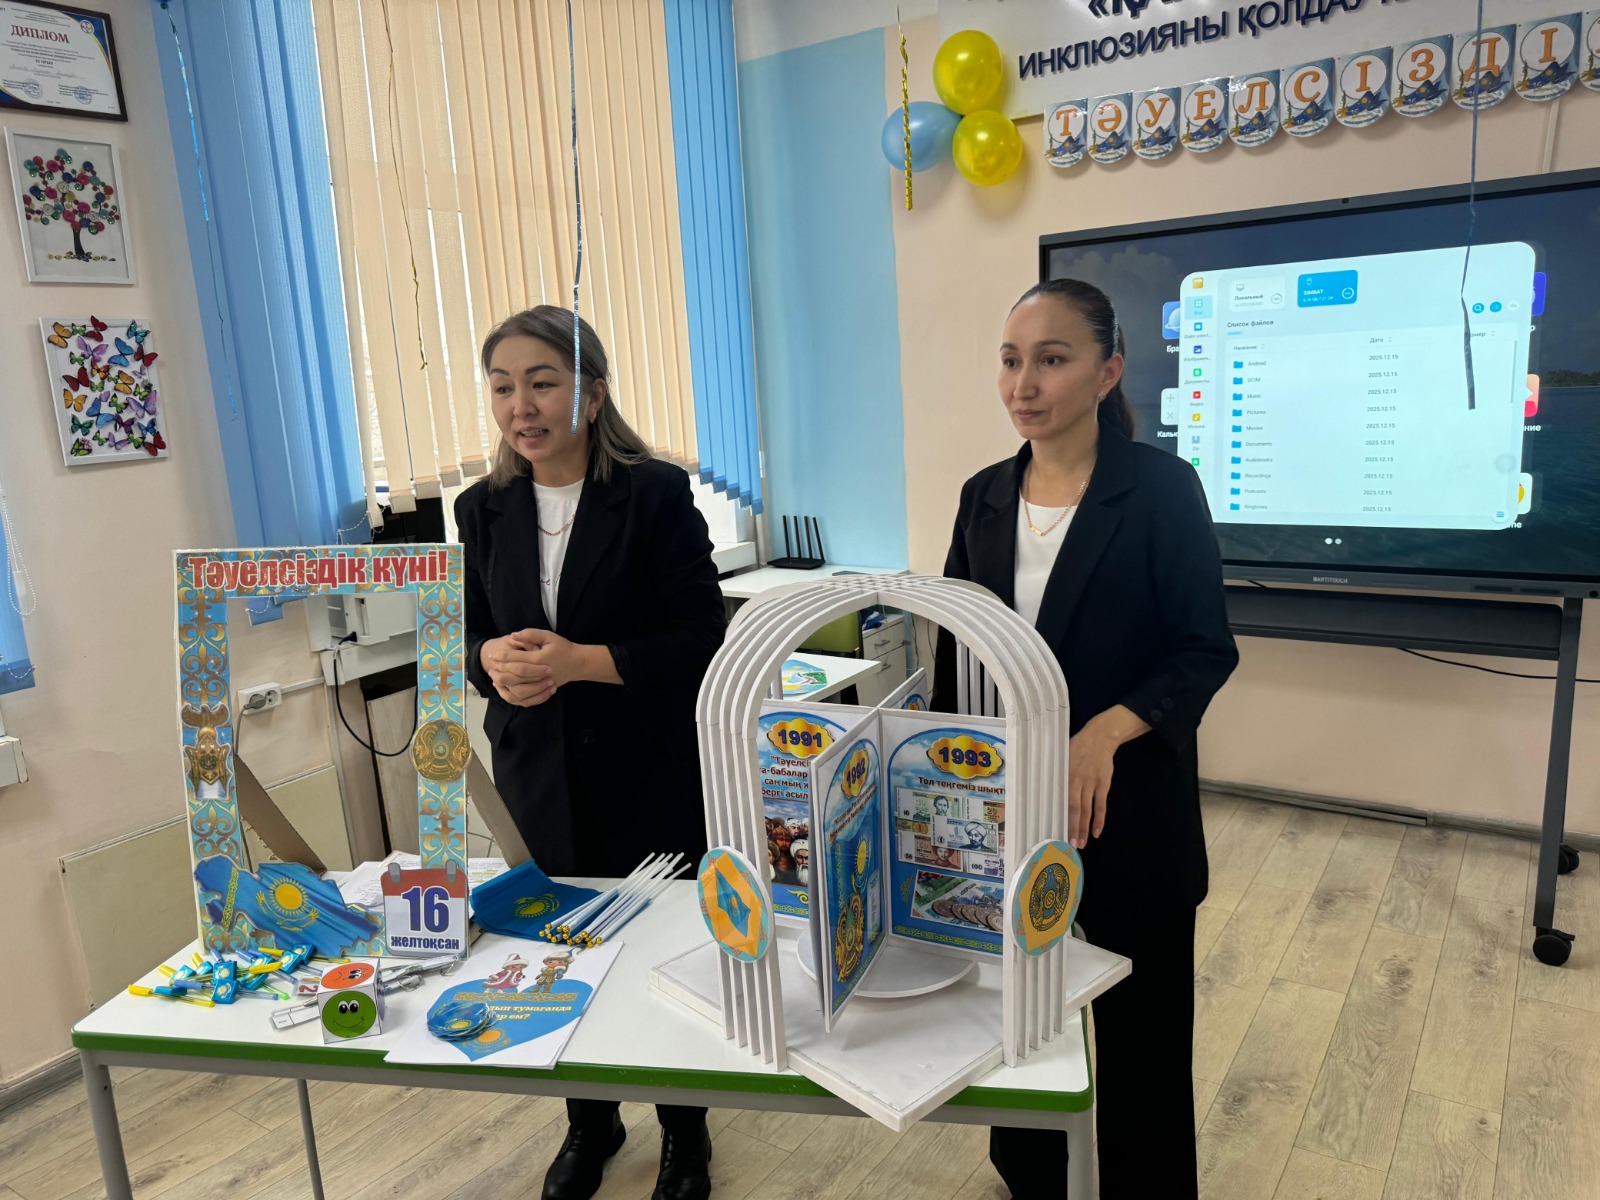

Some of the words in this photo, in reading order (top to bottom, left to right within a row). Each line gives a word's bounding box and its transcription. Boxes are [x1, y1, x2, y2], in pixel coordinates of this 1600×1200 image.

[11, 24, 70, 44] ДИПЛОМ
[1018, 10, 1228, 80] ИНКЛЮЗИЯНЫ
[1054, 19, 1600, 137] ТӘУЕЛСІЗДІ
[1234, 293, 1264, 302] Локальный
[1226, 321, 1250, 329] Список
[1250, 319, 1274, 328] файлов
[188, 553, 367, 591] Тәуелсіздік
[373, 550, 448, 588] күні!
[777, 729, 823, 748] 1991
[770, 755, 811, 767] "Тәуелсі
[938, 746, 992, 768] 1993
[760, 766, 809, 779] а-бабалар
[846, 757, 867, 789] 1992
[764, 778, 780, 786] сан
[781, 780, 802, 790] мың
[936, 780, 976, 792] теңгеміз
[977, 784, 1005, 796] шықт
[401, 886, 450, 934] 16
[390, 935, 460, 951] желтоқсан
